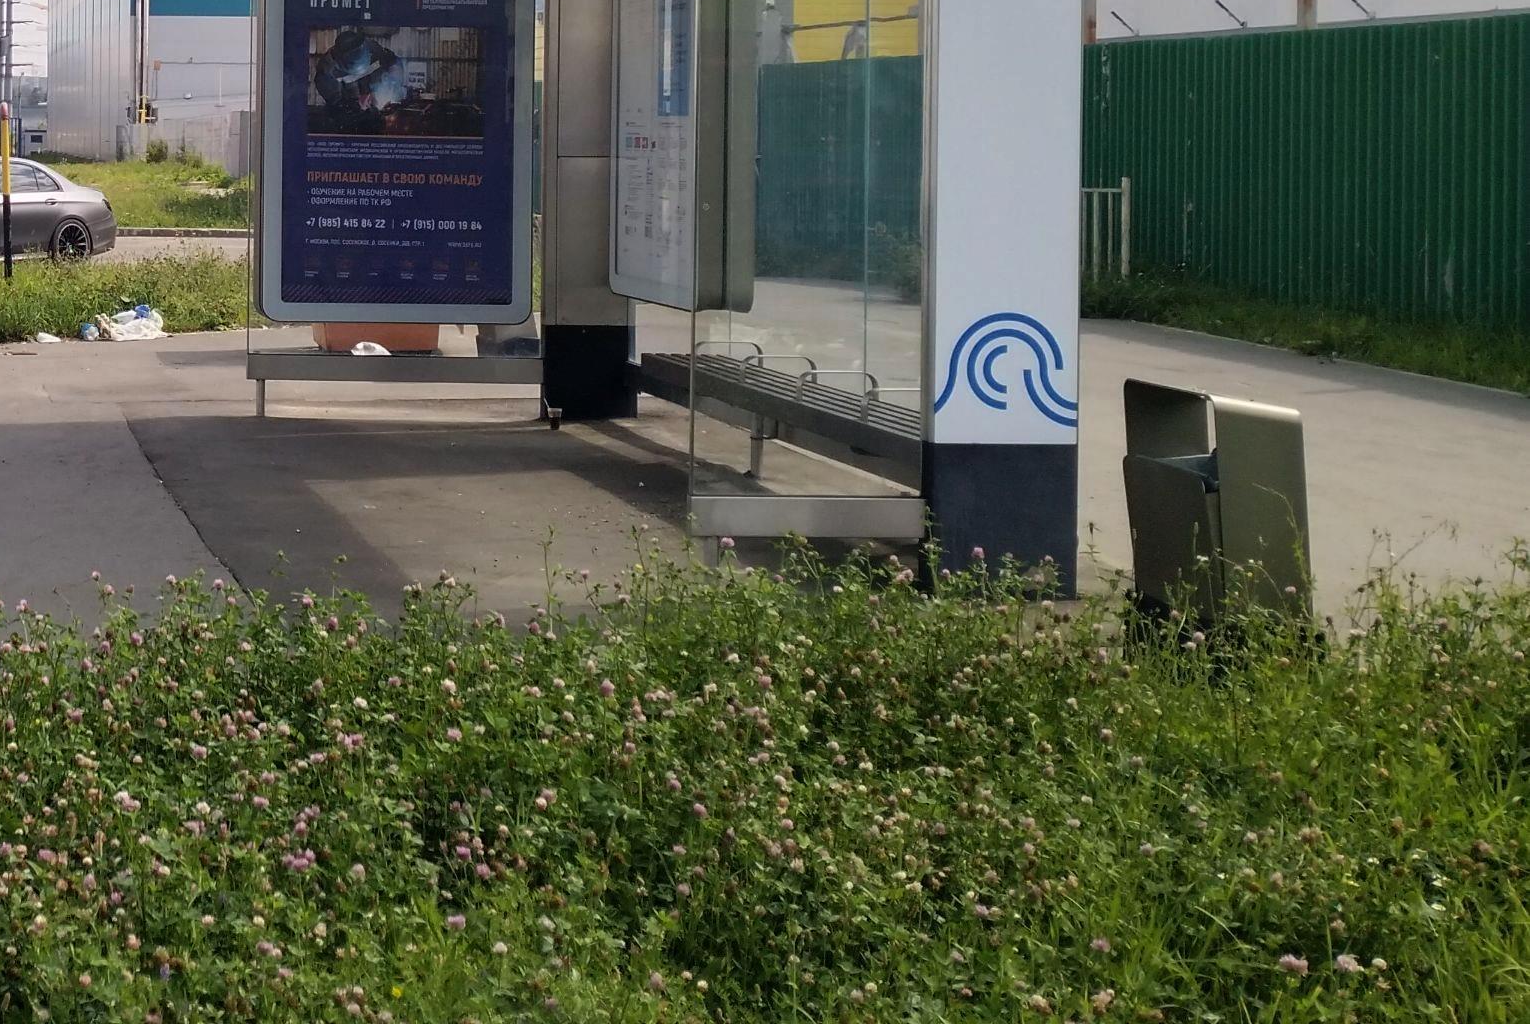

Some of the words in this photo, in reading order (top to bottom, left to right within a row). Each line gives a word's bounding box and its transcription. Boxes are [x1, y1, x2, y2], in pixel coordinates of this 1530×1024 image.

[307, 170, 380, 183] ПРИГЛАШАЕТ
[382, 172, 390, 183] В
[393, 173, 425, 184] СВОЮ
[429, 173, 483, 187] КОМАНДУ
[311, 187, 346, 196] ОБУЧЕНИЕ
[347, 188, 356, 196] НА
[357, 188, 390, 196] РАБОЧЕМ
[391, 189, 413, 197] МЕСТЕ
[310, 196, 358, 205] ОФОРМЛЕНИЕ
[359, 198, 369, 206] ПО
[371, 198, 379, 206] ТК
[381, 198, 392, 206] РФ
[306, 217, 316, 227] +7
[318, 216, 341, 228] (985)
[344, 218, 358, 228] 415
[361, 218, 372, 228] 84
[375, 219, 386, 228] 22
[400, 219, 410, 229] +7
[414, 218, 435, 230] (915)
[438, 220, 455, 230] 000
[459, 221, 468, 230] 19
